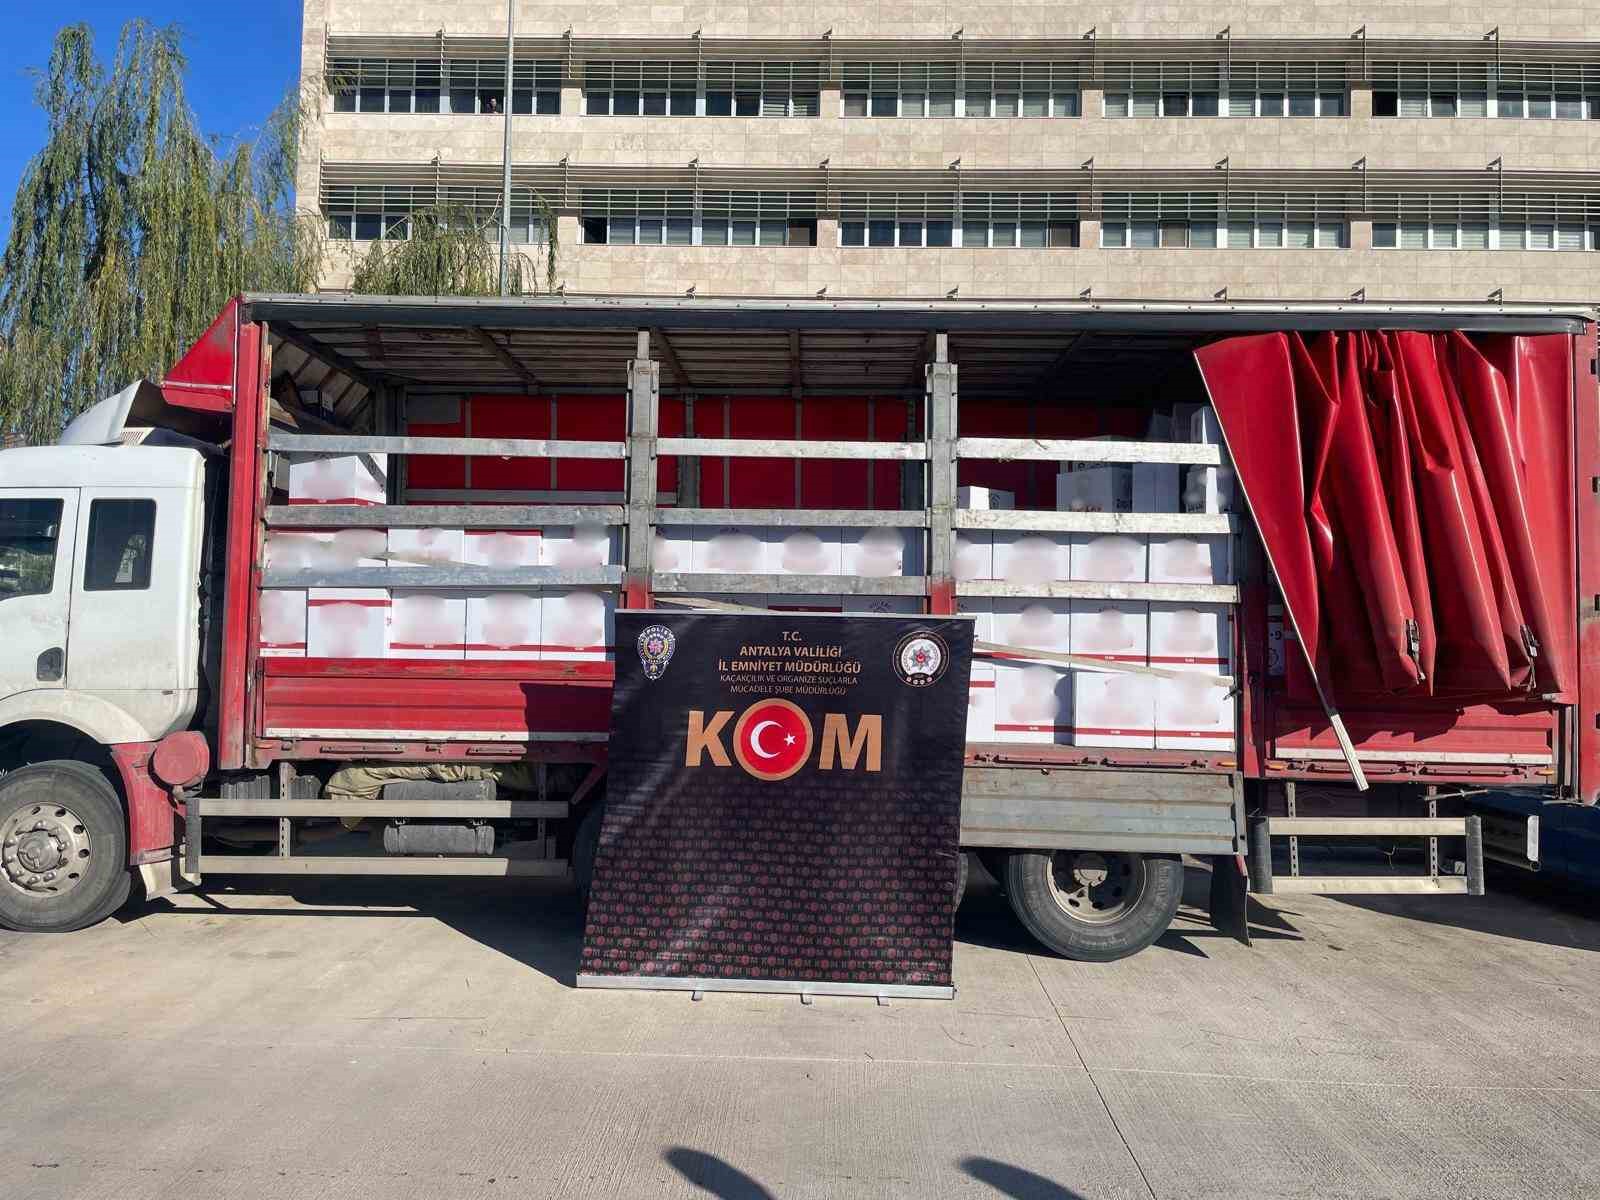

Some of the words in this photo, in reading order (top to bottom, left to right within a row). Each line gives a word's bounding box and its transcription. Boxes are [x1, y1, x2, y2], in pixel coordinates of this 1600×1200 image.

[782, 631, 802, 641] T.C.
[739, 646, 791, 657] ANTALYA
[793, 645, 842, 657] VALİLİĞİ
[718, 658, 728, 671] İL
[731, 659, 783, 671] EMNİYET
[784, 660, 861, 673] MÜDÜRLÜĞÜ
[720, 674, 765, 684] KAÇAKÇILIK
[817, 676, 858, 685] SUÇLARLA
[730, 685, 772, 694] MÜCADELE
[775, 686, 793, 695] ŞUBE
[685, 697, 882, 781] KOM
